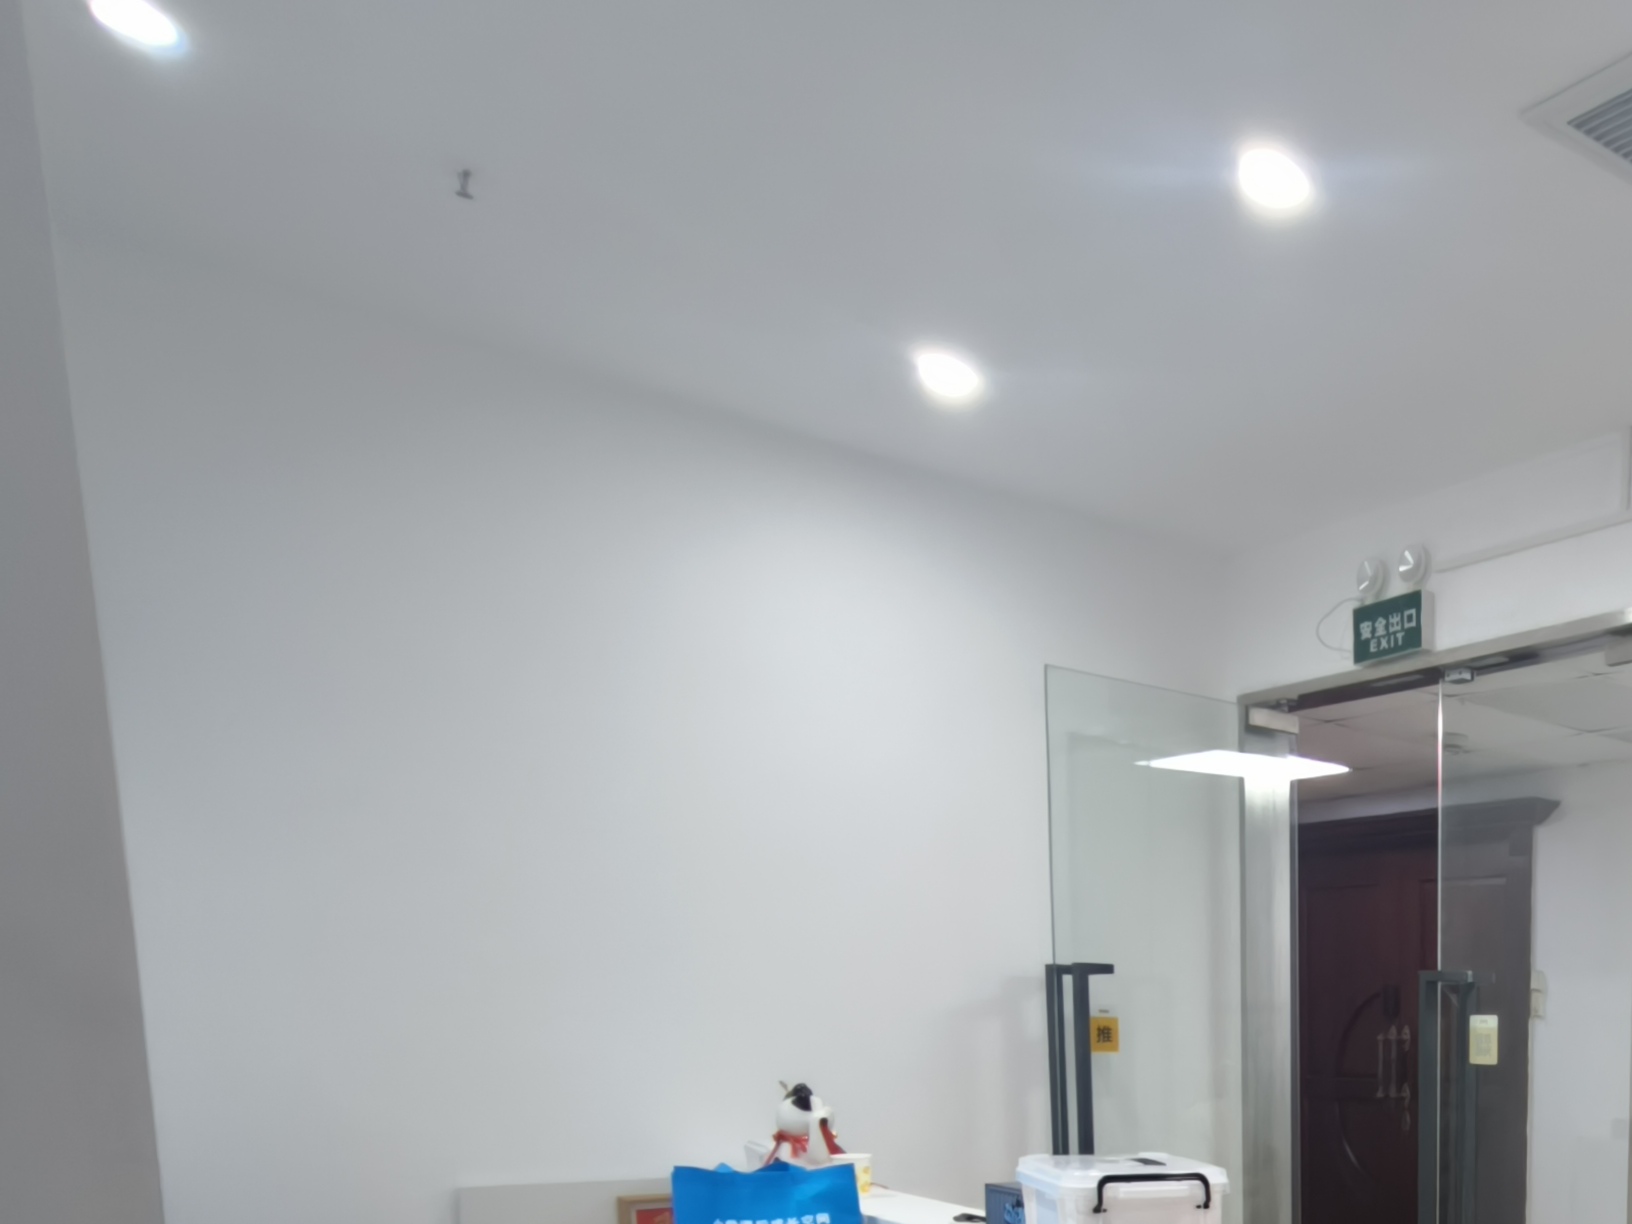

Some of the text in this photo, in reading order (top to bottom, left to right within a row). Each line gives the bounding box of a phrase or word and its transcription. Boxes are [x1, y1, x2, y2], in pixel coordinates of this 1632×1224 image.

[1359, 608, 1417, 640] 安全出口
[1370, 632, 1405, 652] EXIT
[1097, 1025, 1112, 1043] 推
